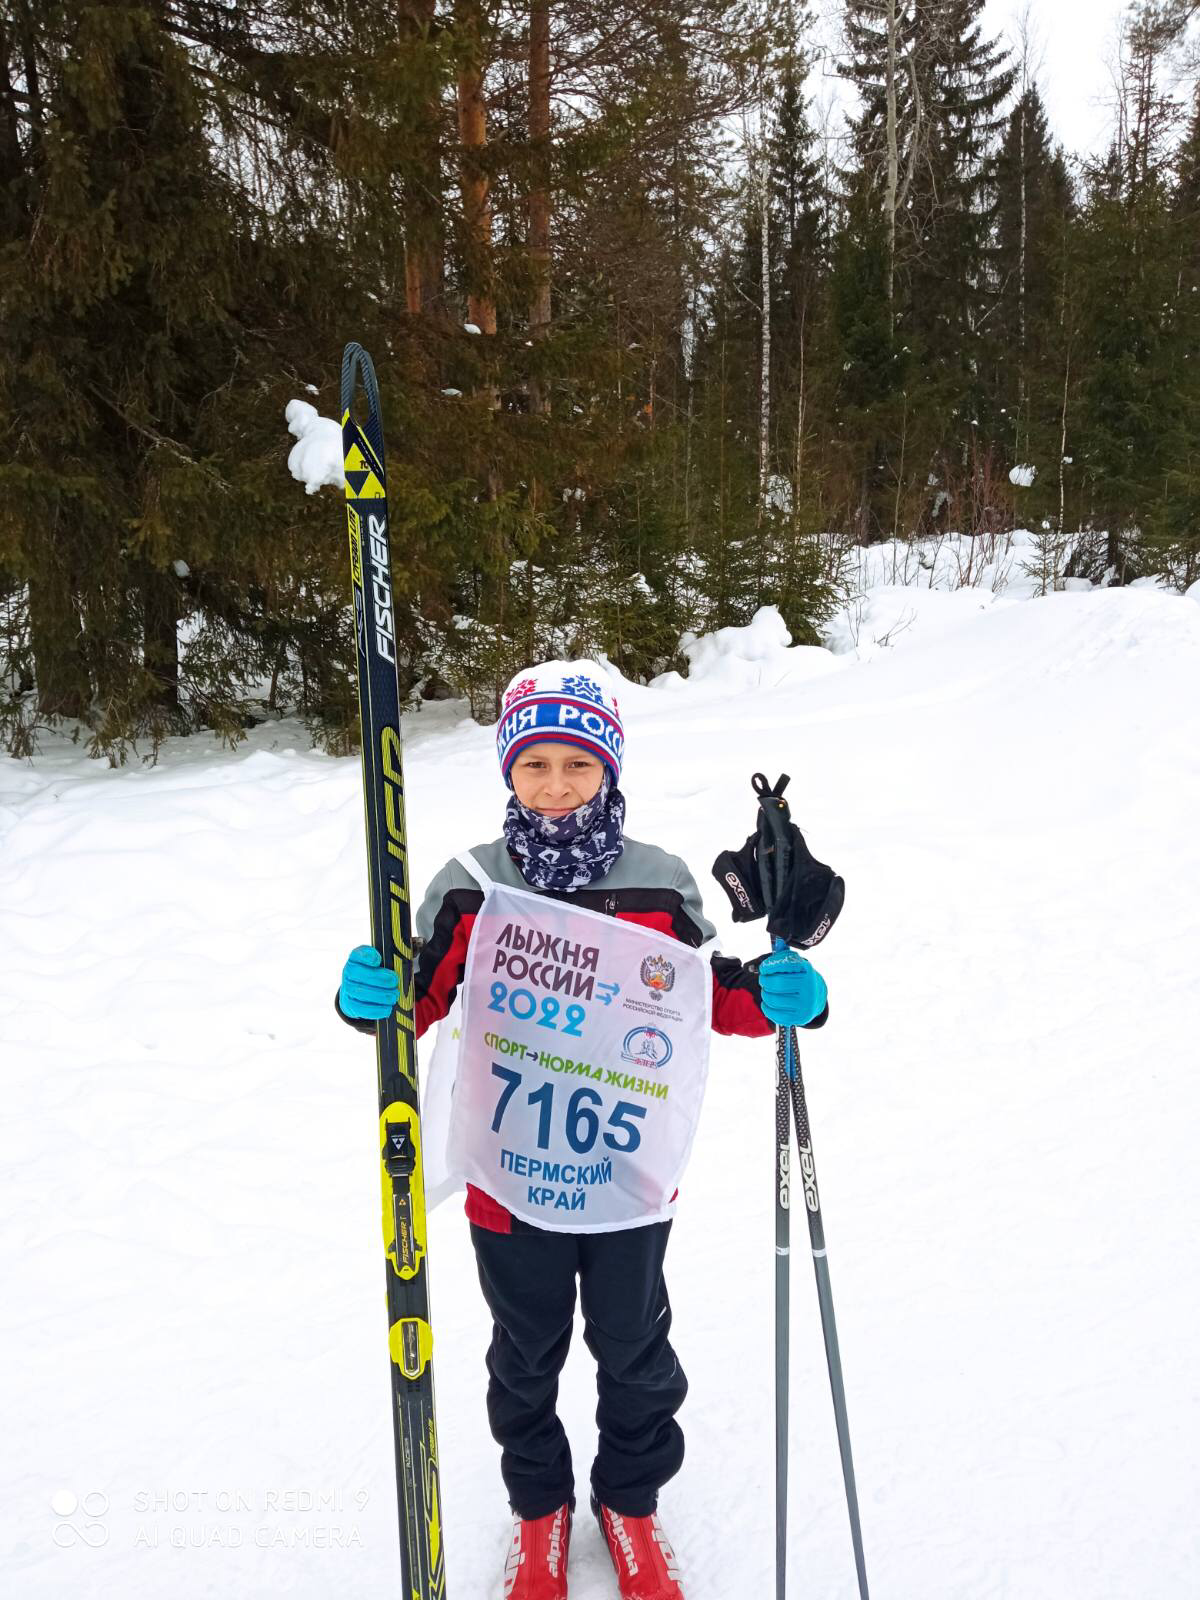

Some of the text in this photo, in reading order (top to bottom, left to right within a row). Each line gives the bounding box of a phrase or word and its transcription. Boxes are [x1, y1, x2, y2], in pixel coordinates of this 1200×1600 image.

[368, 514, 395, 664] FISCHER
[725, 872, 747, 908] exel
[496, 923, 600, 973] ЛЫЖНЯ
[492, 949, 595, 1001] РОССИИ
[487, 981, 586, 1037] 2022
[484, 1032, 527, 1060] СПОРТ
[539, 1052, 601, 1082] НОРМА
[603, 1069, 670, 1100] ЖИЗНИ
[491, 1062, 648, 1155] 7165
[500, 1148, 612, 1185] ПЕРМСКИЙ
[800, 1139, 819, 1212] exel
[527, 1186, 586, 1211] КРАЙ
[401, 1221, 409, 1264] FISCHER
